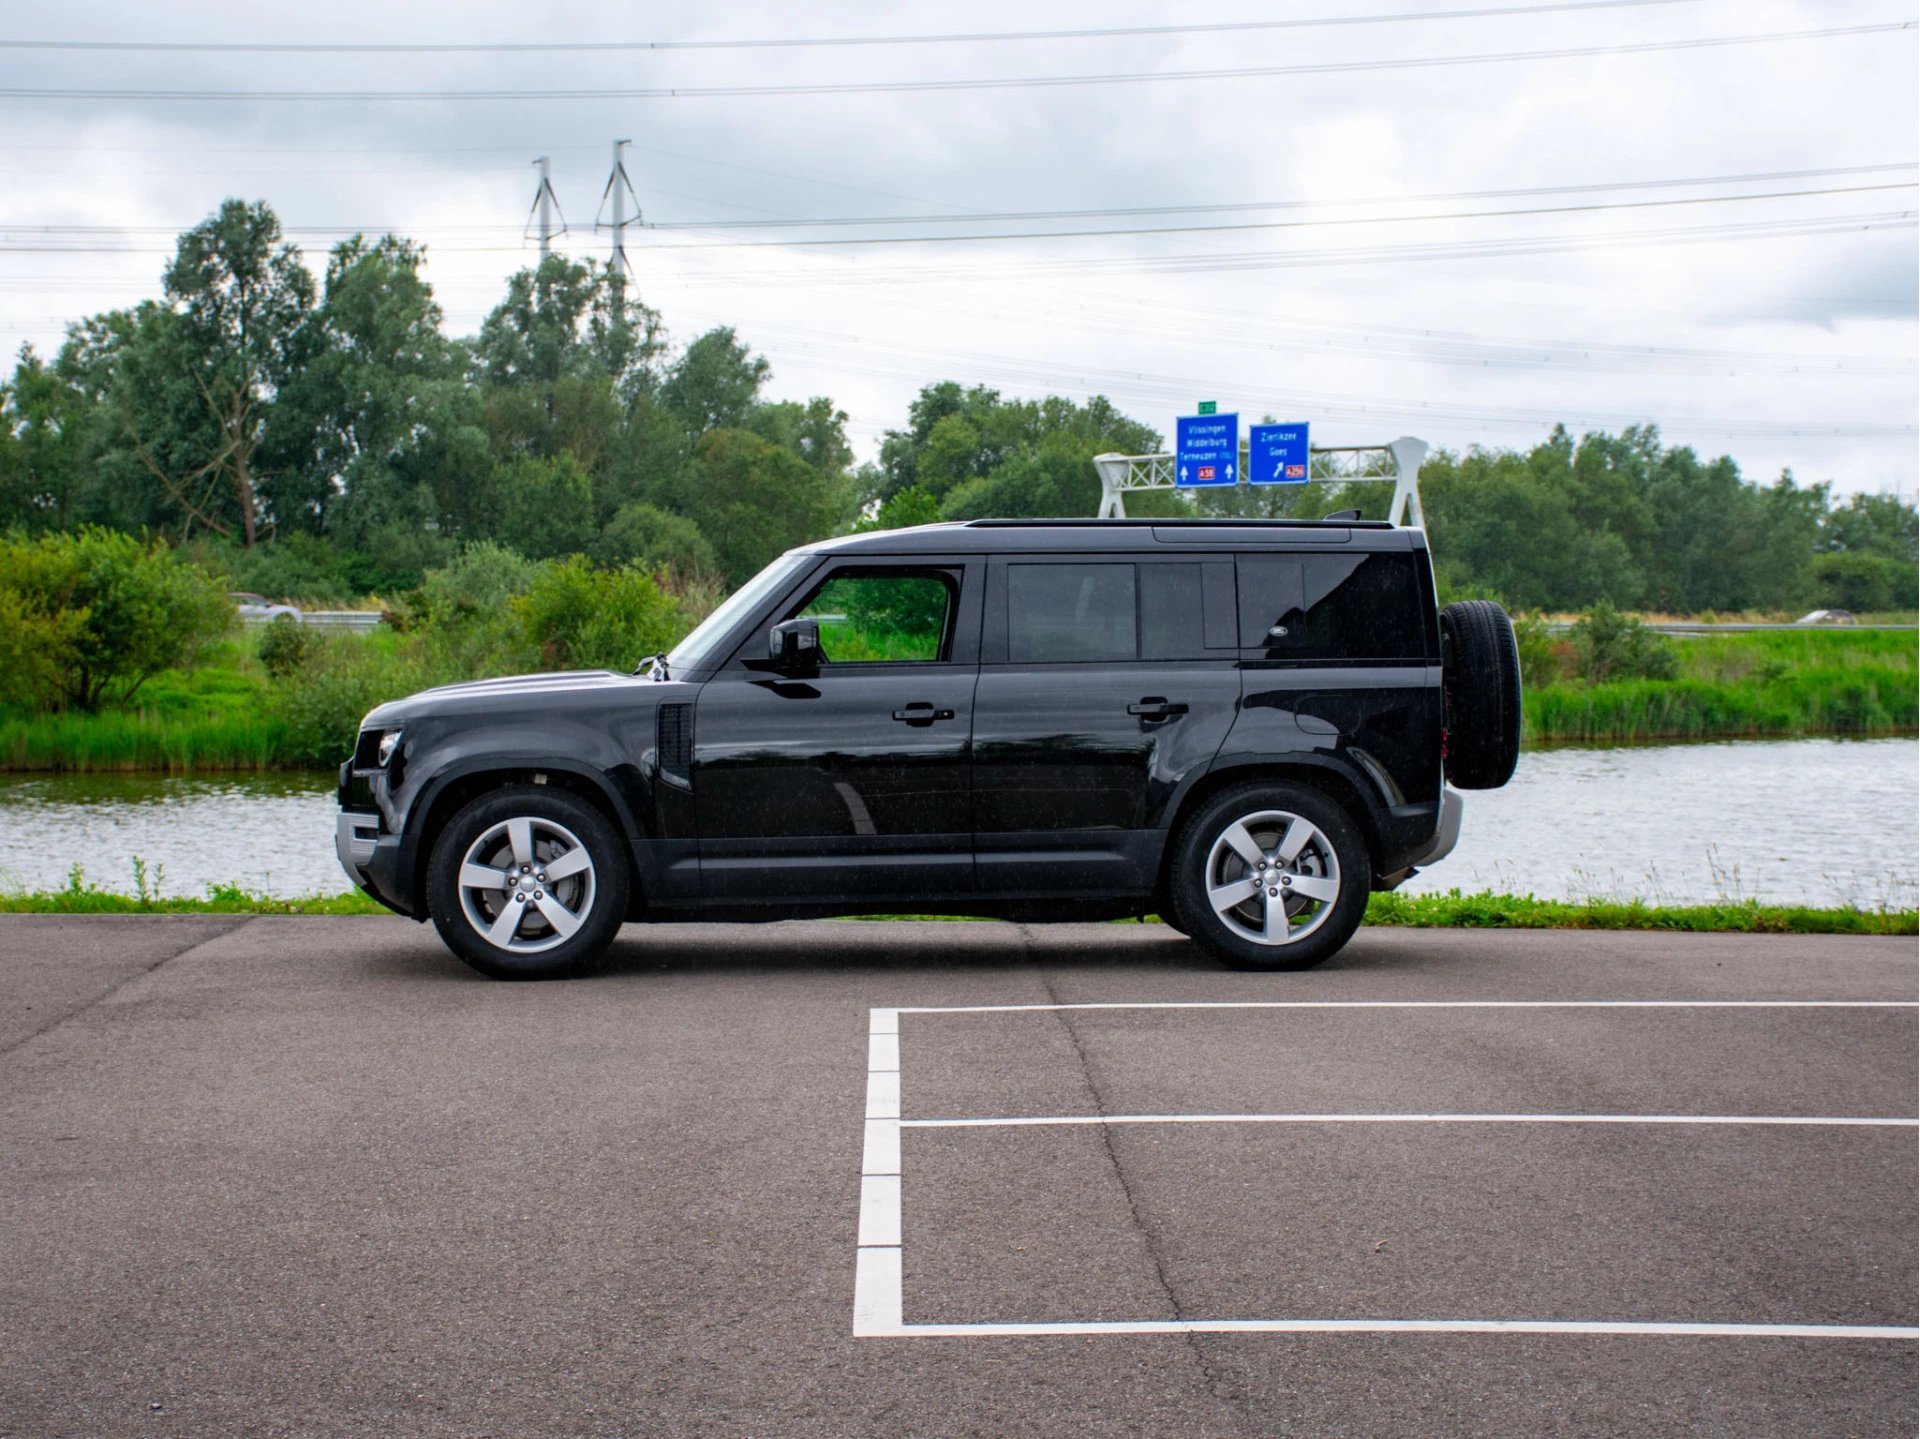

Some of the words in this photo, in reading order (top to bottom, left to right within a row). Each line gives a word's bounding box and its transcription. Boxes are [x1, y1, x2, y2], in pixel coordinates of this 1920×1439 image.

[1260, 432, 1297, 442] Zierikzee
[1186, 438, 1227, 449] Middelburg
[1180, 451, 1217, 461] Terneuszen
[1269, 447, 1288, 457] Goes
